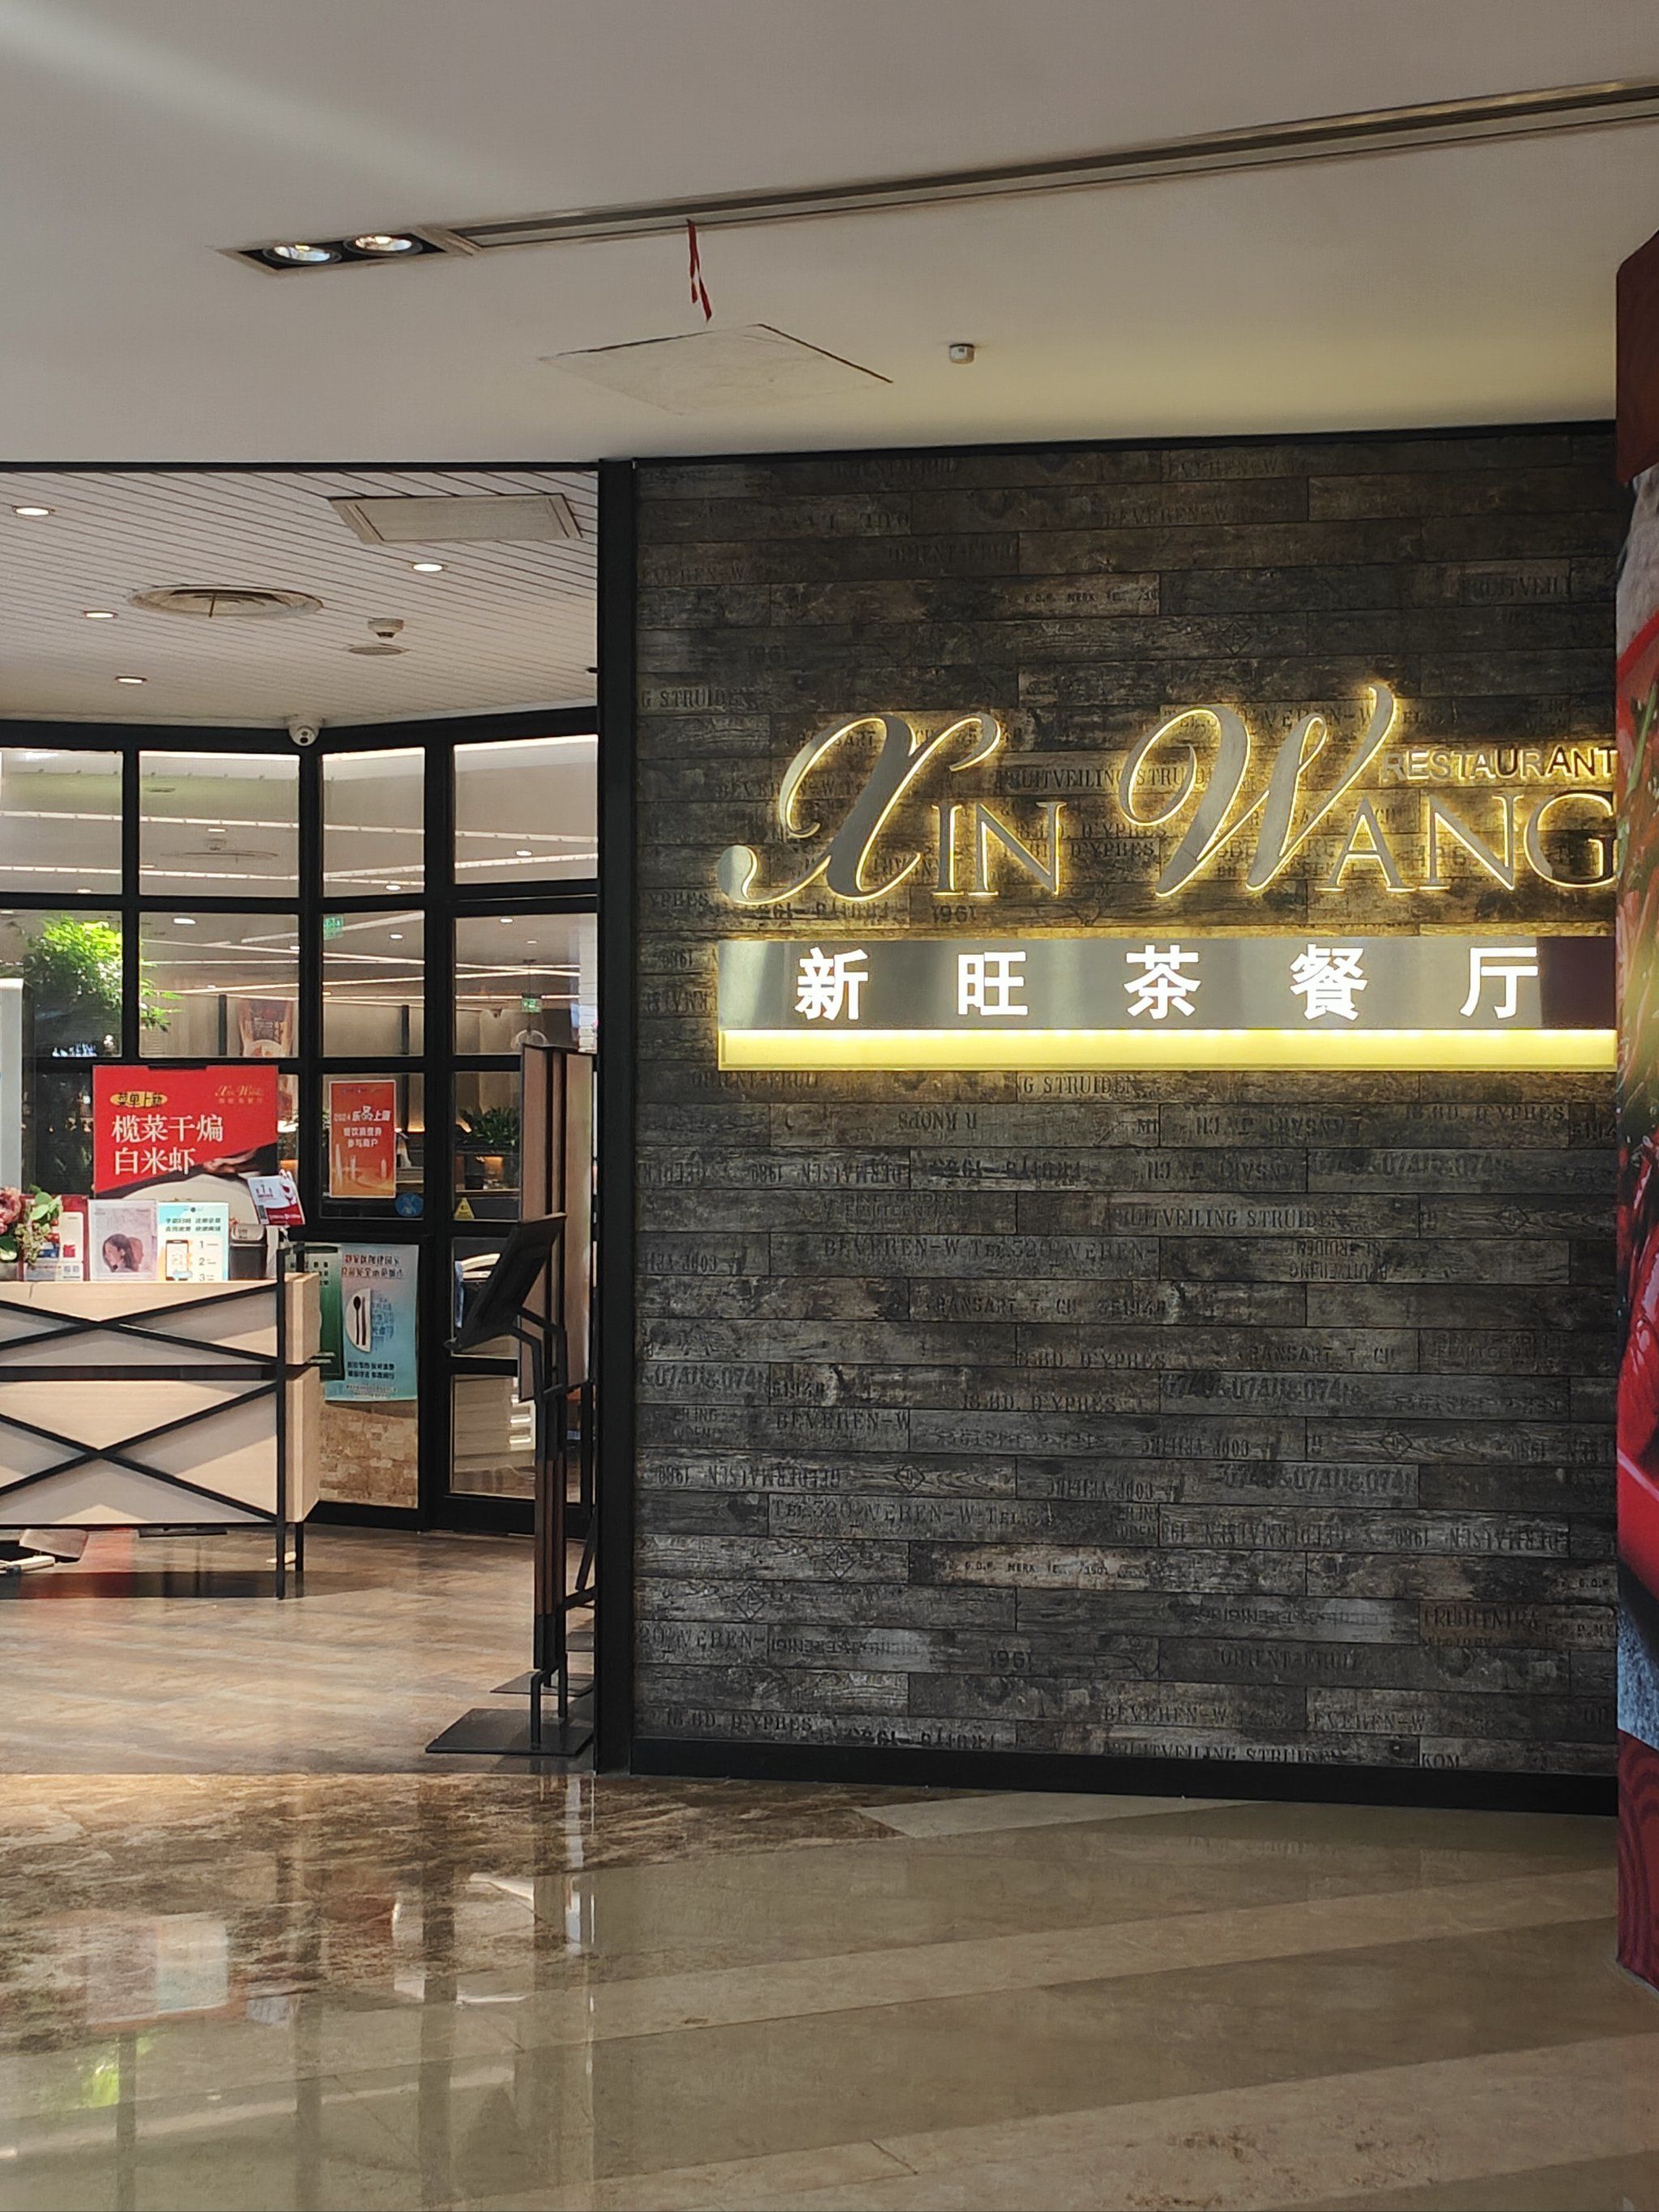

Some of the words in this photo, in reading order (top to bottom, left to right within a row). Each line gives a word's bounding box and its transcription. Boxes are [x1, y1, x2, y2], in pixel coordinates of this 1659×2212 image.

[1381, 746, 1617, 781] RESTAURANT
[793, 941, 1540, 1022] 新旺茶餐厅
[111, 1114, 224, 1143] 榄菜干煸
[114, 1147, 196, 1175] 白米虾
